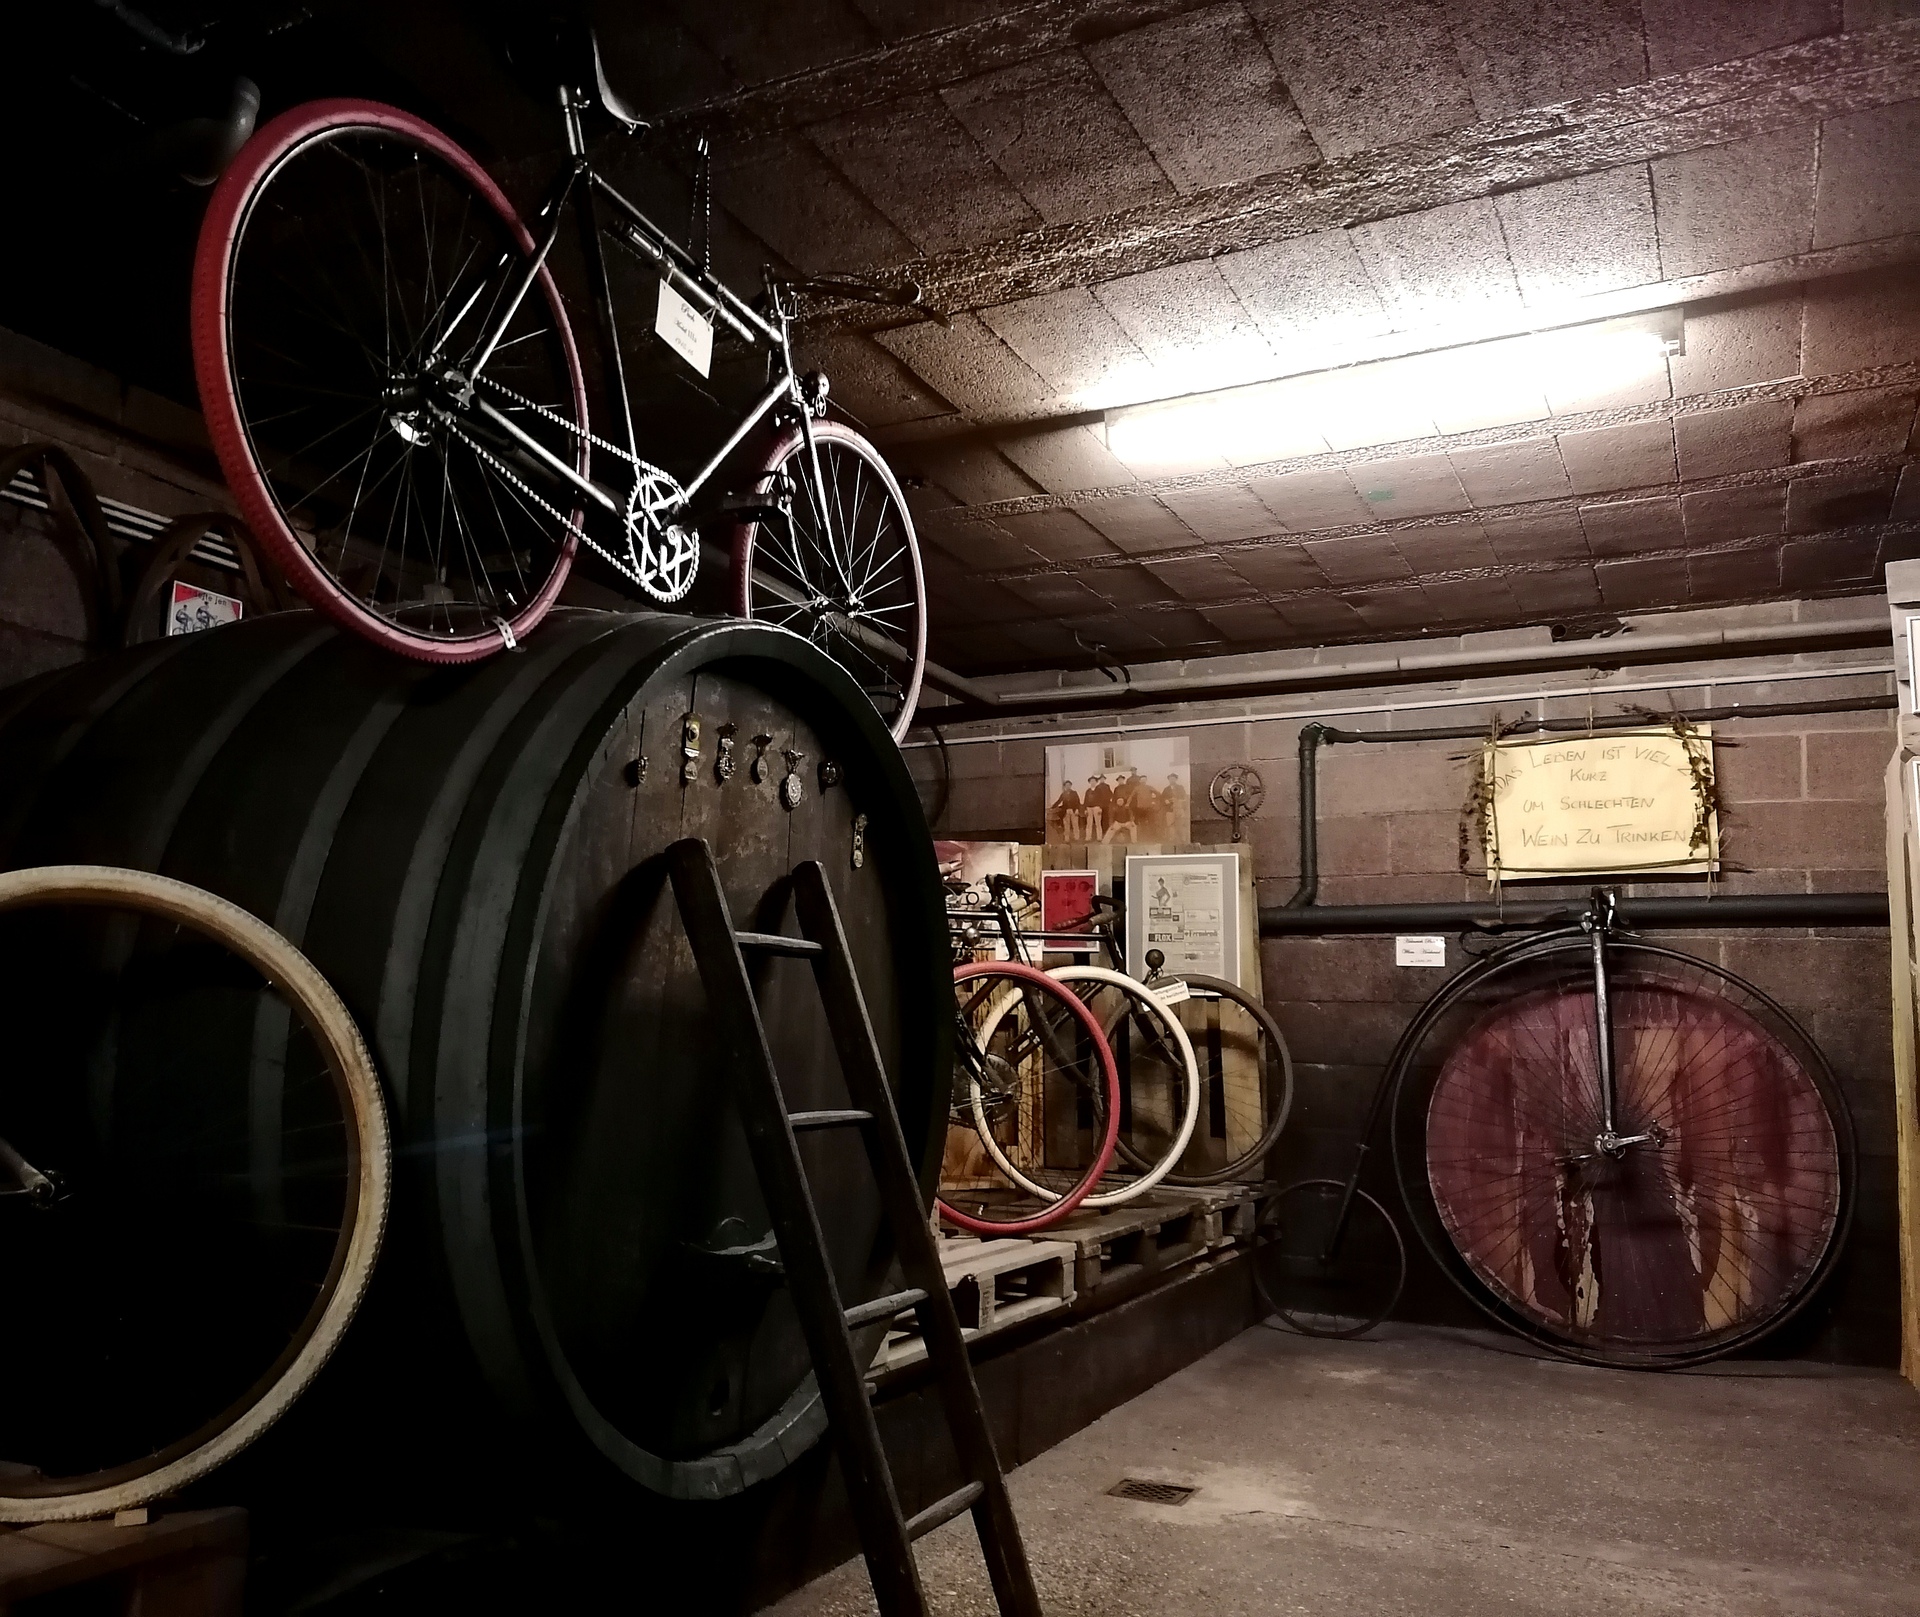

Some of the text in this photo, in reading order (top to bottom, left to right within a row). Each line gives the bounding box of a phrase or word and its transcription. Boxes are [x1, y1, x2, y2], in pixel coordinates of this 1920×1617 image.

[1494, 746, 1671, 789] DAS LEBEN IST VIEL
[1570, 768, 1607, 782] KURZ
[1523, 796, 1655, 813] UM SCHLECHTEN
[1521, 823, 1687, 847] WEIN ZU TRINKEN
